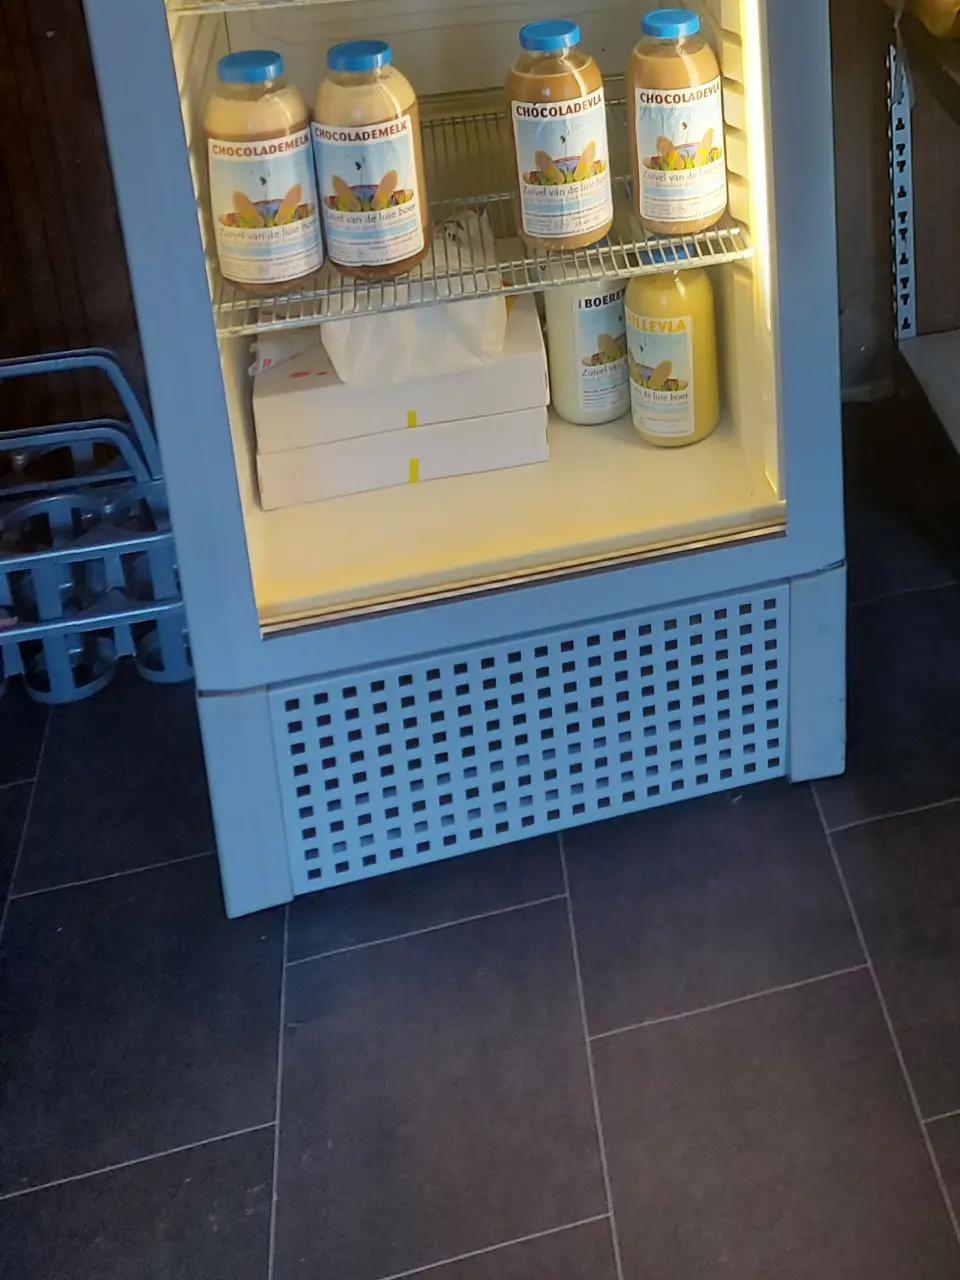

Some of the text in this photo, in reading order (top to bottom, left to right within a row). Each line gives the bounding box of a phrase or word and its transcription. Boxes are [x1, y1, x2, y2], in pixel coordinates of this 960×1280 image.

[640, 82, 719, 104] CHOCOLADEVLA
[516, 93, 602, 118] CHOCOLADEVLA
[314, 120, 408, 142] CHOCOLADEMELK
[212, 130, 309, 157] CHOCOLADEMELK
[643, 170, 666, 182] Zuivel
[669, 172, 685, 182] van
[523, 180, 594, 197] Zuivel van de luie
[346, 214, 362, 224] van
[364, 211, 376, 222] de
[378, 208, 396, 221] luie
[398, 204, 416, 217] boer
[248, 230, 264, 240] van
[267, 226, 280, 240] de
[582, 366, 607, 377] Zuivel
[653, 392, 668, 401] luie
[670, 392, 688, 401] boer
